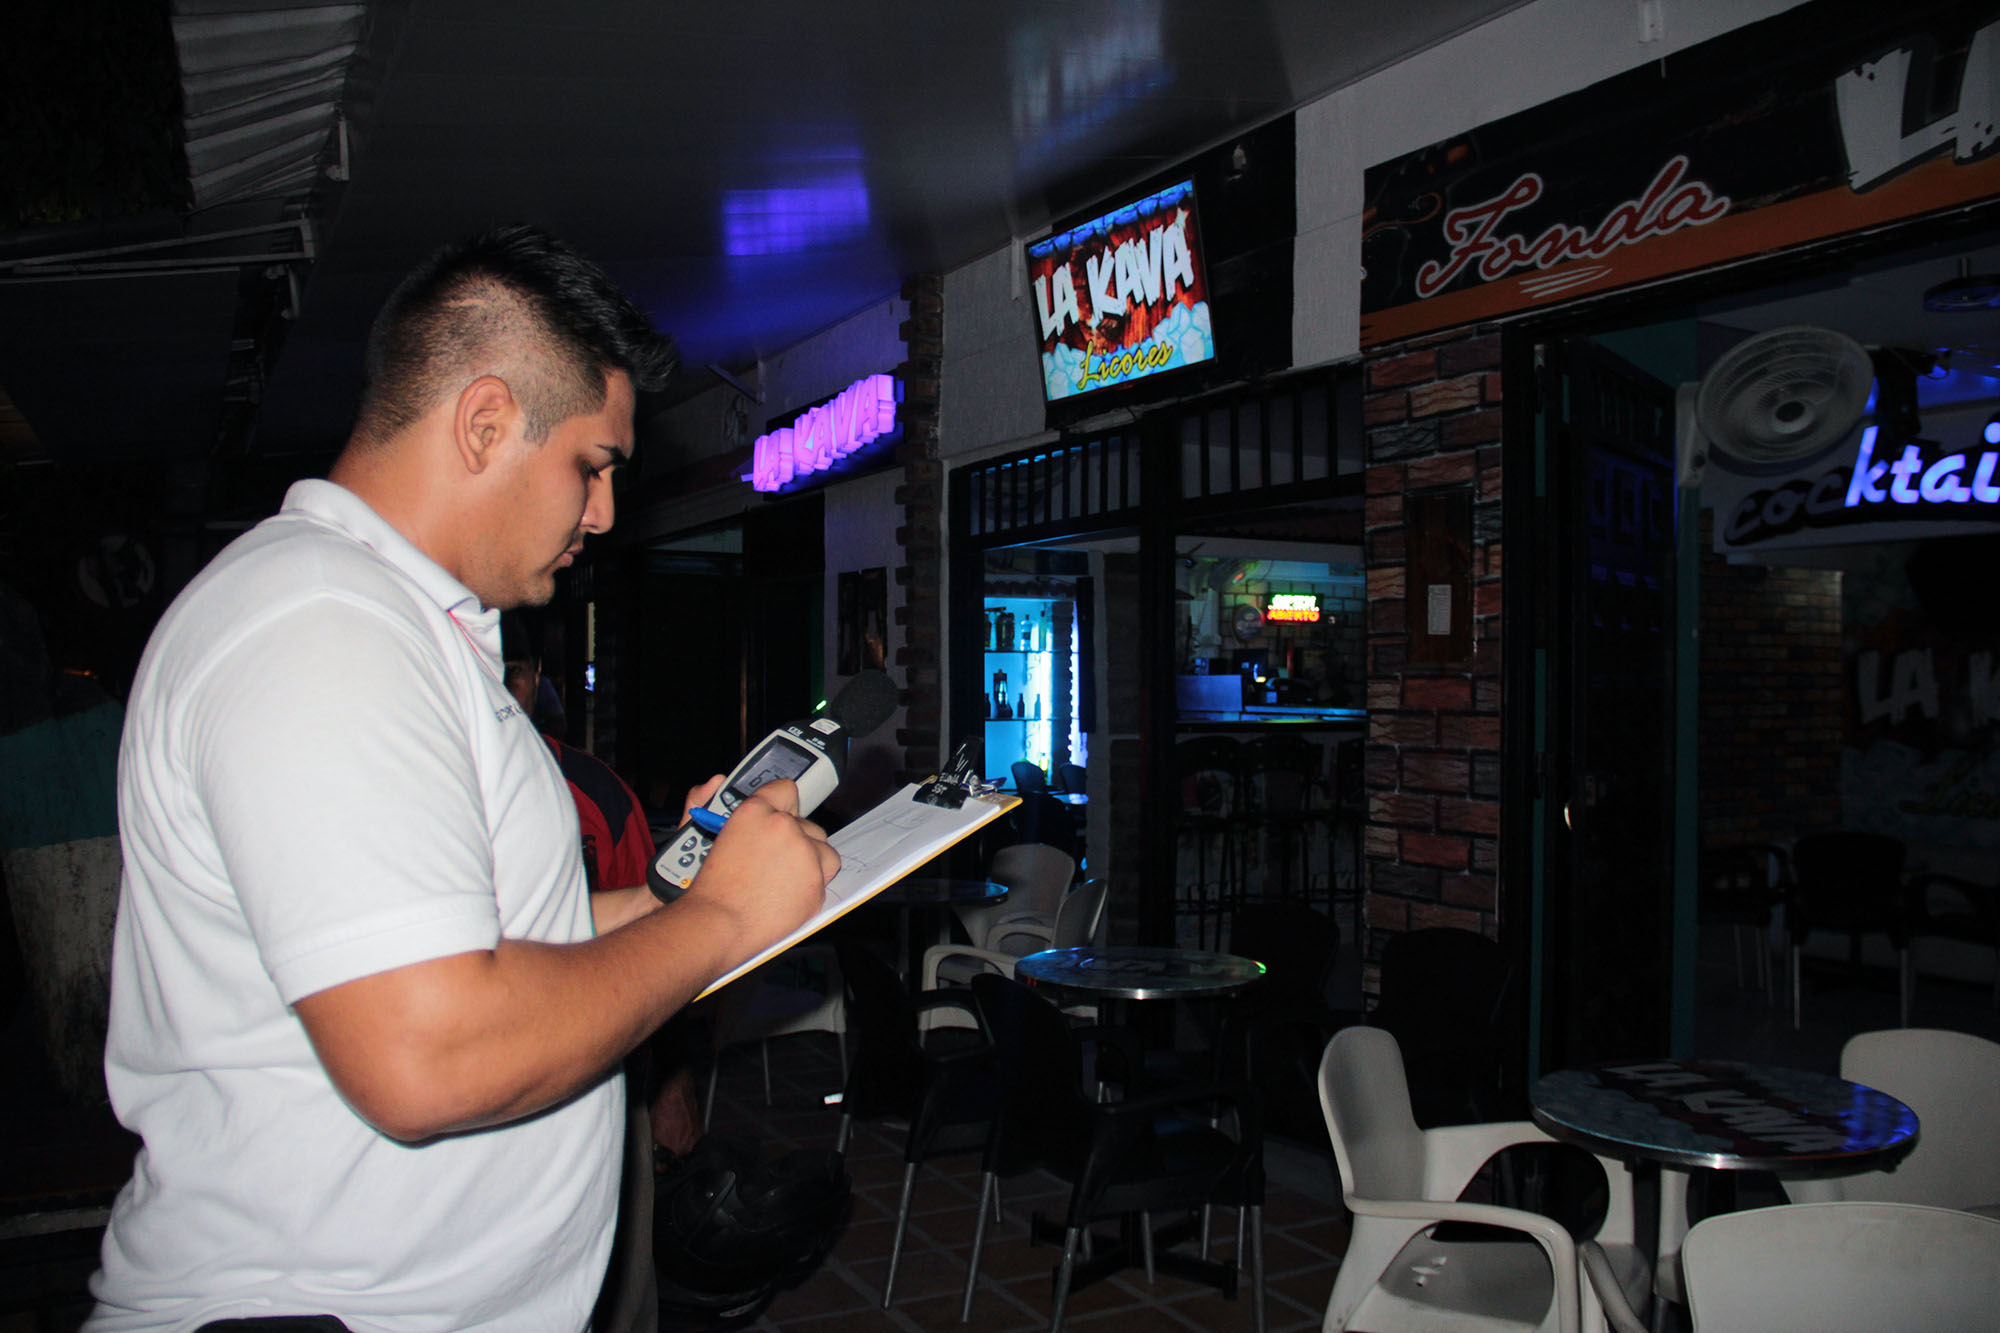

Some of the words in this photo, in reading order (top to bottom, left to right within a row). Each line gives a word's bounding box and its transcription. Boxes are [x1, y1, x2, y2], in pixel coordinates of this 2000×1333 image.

[1416, 154, 1730, 298] Fonda
[1034, 262, 1080, 341] LA
[1086, 223, 1195, 329] KAVA
[1076, 340, 1173, 390] Licores
[1857, 648, 1940, 727] LA
